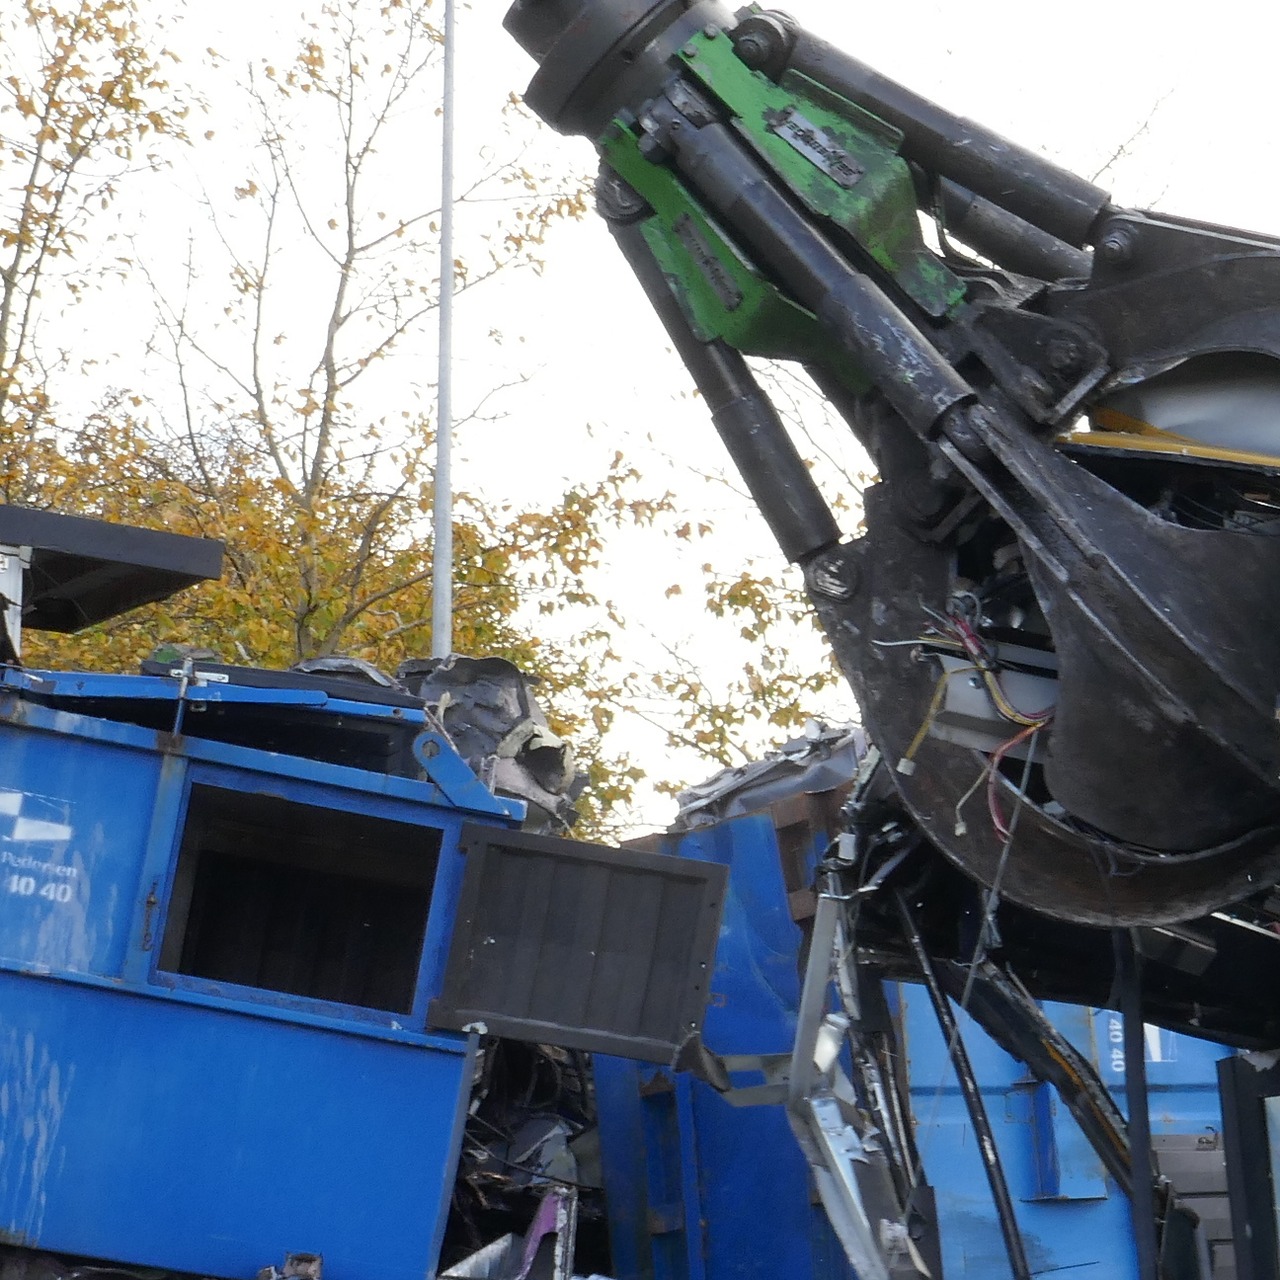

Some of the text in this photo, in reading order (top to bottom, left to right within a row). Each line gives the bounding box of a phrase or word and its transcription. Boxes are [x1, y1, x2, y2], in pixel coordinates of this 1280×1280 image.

[40, 883, 72, 903] 40
[1109, 1018, 1125, 1072] 40 40
